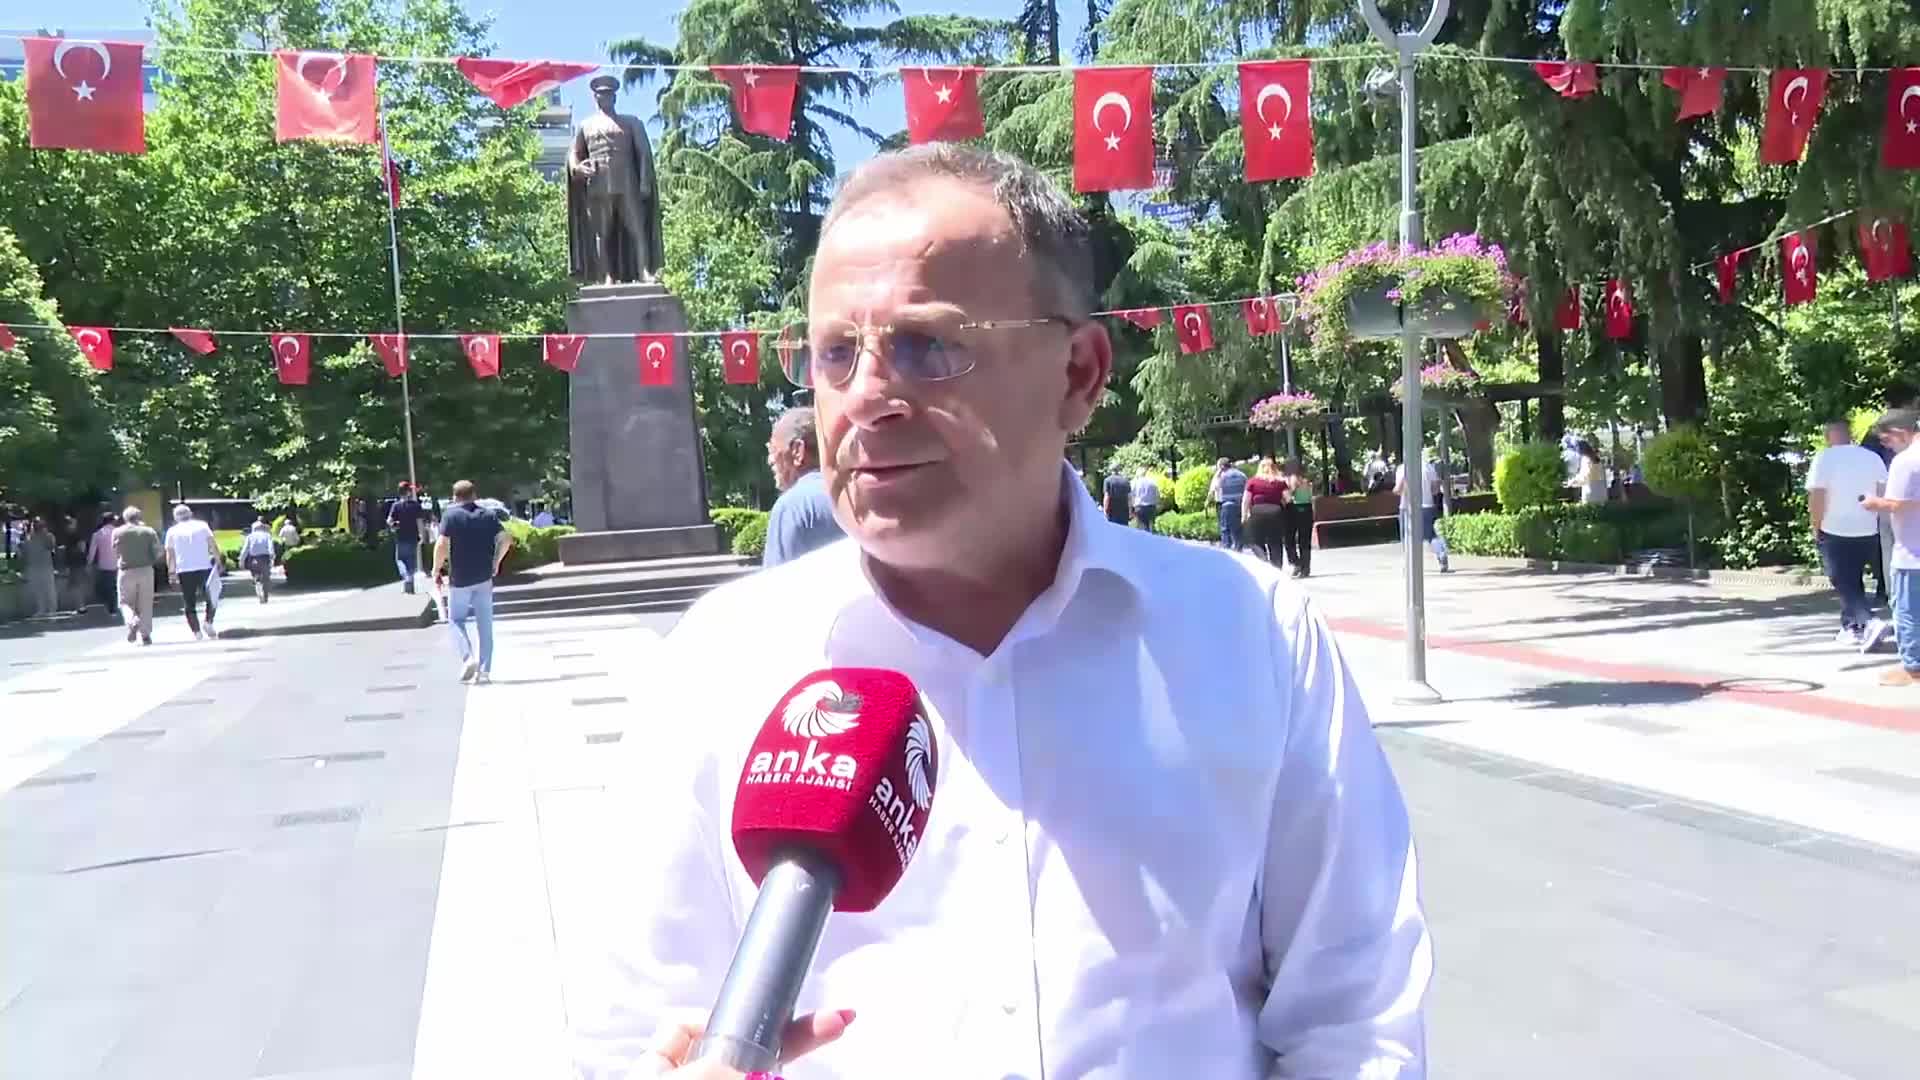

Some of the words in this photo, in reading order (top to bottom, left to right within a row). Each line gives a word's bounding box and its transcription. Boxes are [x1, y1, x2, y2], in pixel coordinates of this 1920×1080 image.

[750, 739, 858, 780] anka
[745, 772, 792, 785] HABER
[795, 773, 853, 792] AJANSI
[868, 795, 896, 835] HABER
[875, 777, 918, 862] anka
